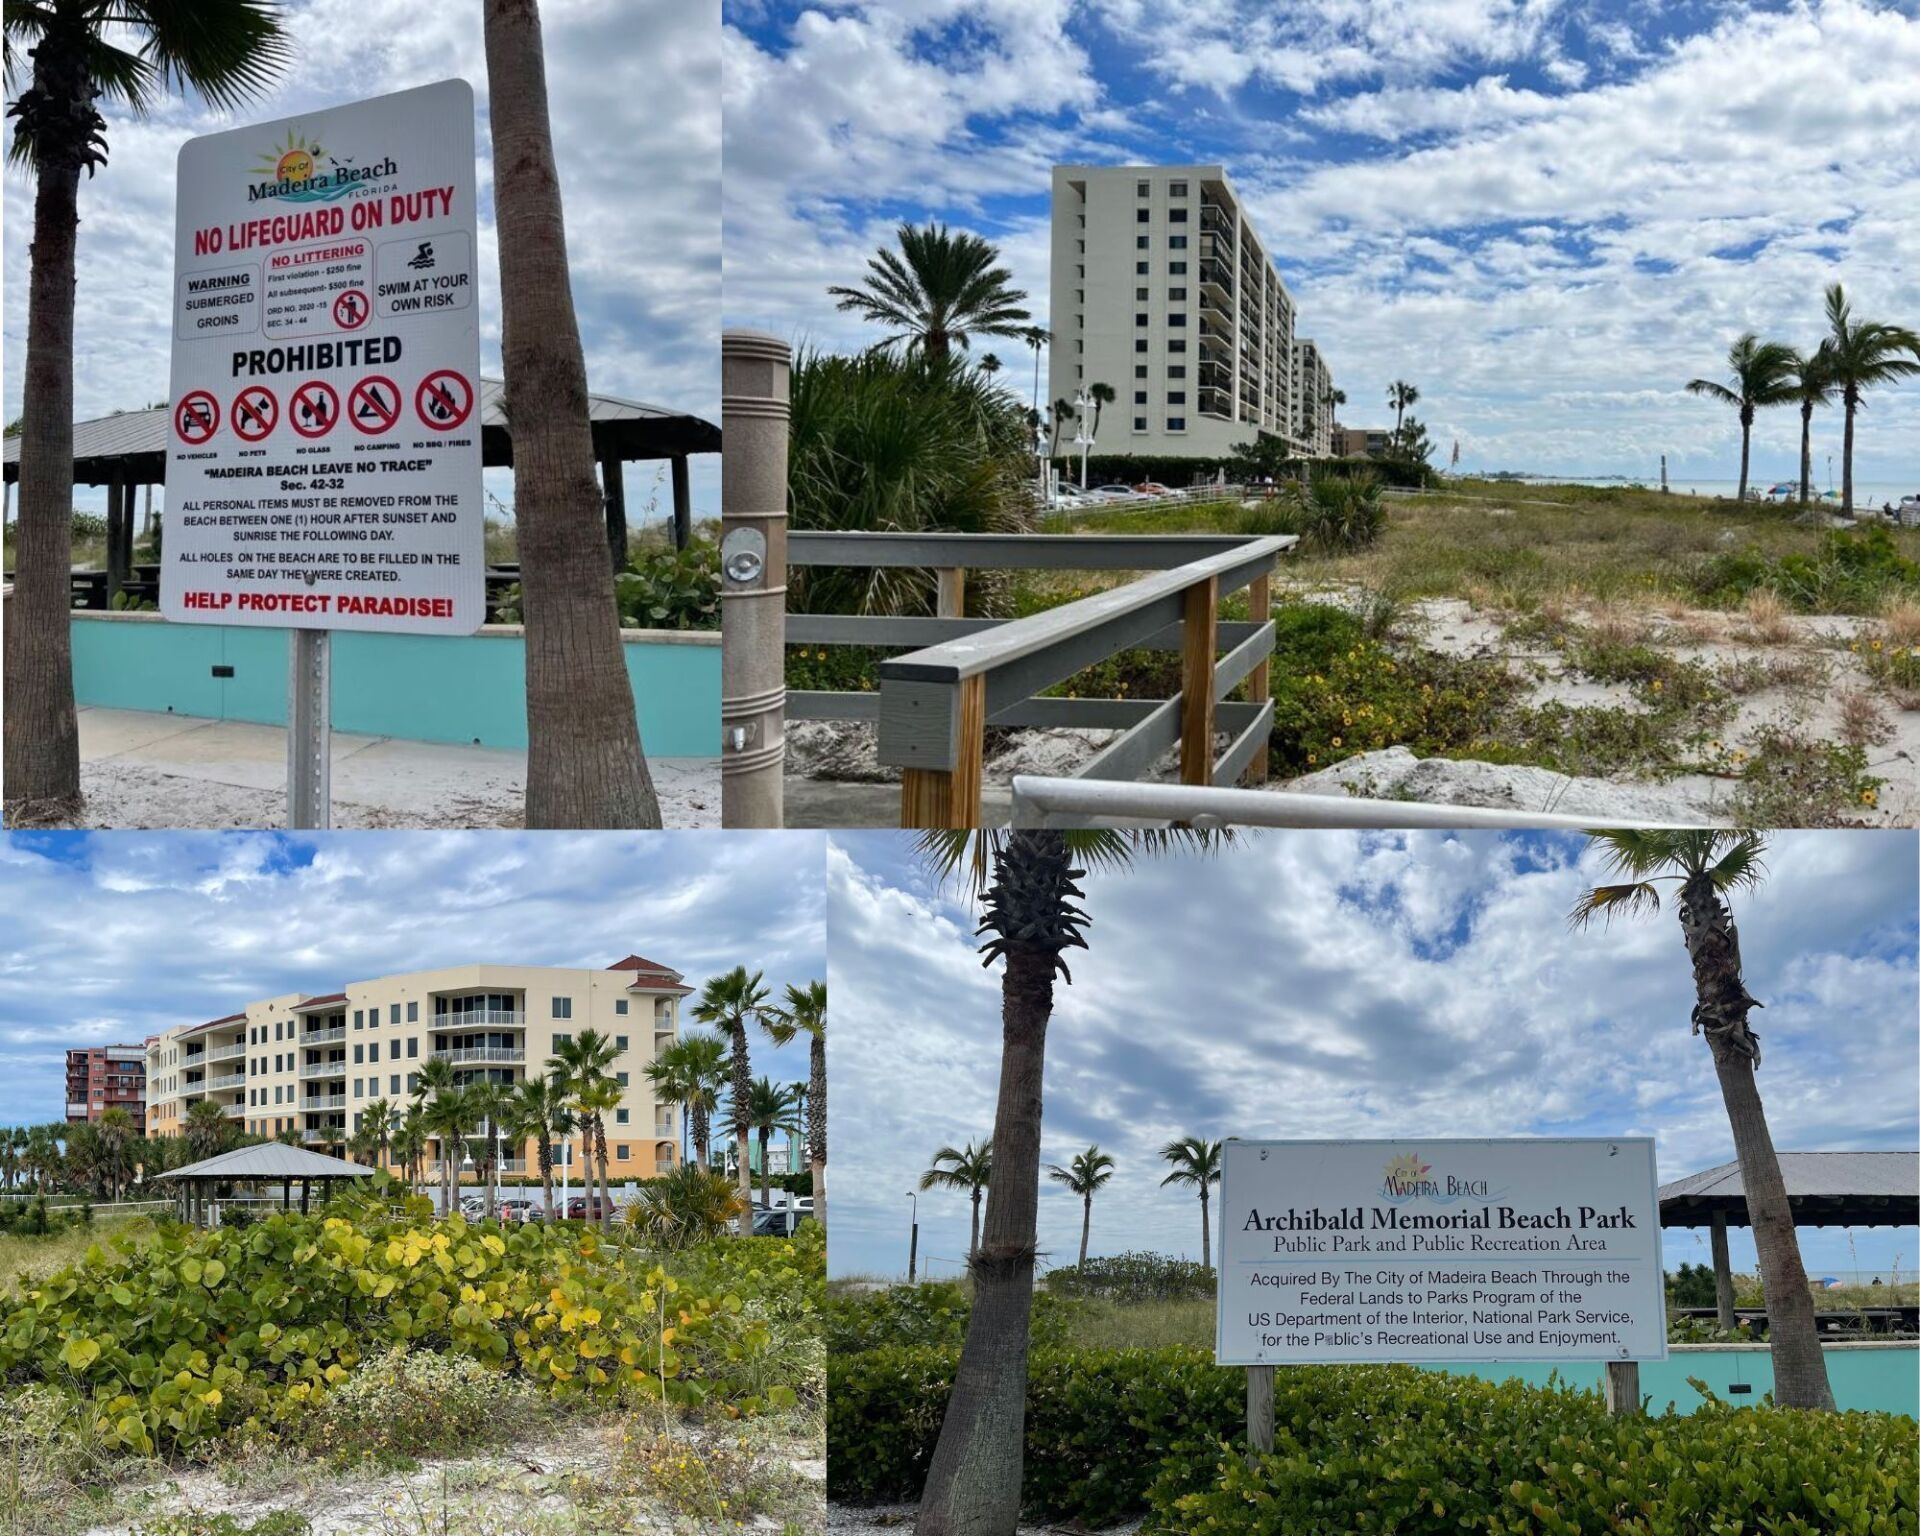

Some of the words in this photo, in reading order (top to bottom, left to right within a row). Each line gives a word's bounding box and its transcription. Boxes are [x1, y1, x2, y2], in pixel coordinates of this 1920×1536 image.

[248, 174, 328, 201] Madeira
[336, 157, 398, 184] Beach
[349, 184, 398, 198] FLORIDA
[195, 227, 222, 256] NO
[229, 207, 344, 250] LIFEGUARD
[351, 200, 382, 230] ON
[391, 186, 454, 222] DUTY
[272, 256, 290, 267] NO
[294, 244, 364, 263] LITTERING
[287, 269, 319, 280] violation
[326, 266, 344, 275] $250
[188, 274, 251, 292] WARNING
[268, 290, 278, 298] All
[329, 281, 346, 290] $500
[378, 281, 410, 297] SWIM
[414, 278, 428, 291] AT
[430, 273, 469, 290] YOUR
[186, 292, 255, 311] SUBMERGED
[391, 296, 421, 312] OWN
[424, 292, 455, 308] RISK
[197, 314, 239, 329] GROINS
[233, 335, 402, 377] PROHIBITED
[266, 463, 309, 476] BEACH
[312, 462, 353, 475] LEAVE
[356, 460, 382, 473] NO
[280, 479, 307, 491] Sec.
[310, 479, 345, 490] 42-32
[182, 500, 201, 511] ALL
[203, 499, 256, 510] PERSONAL
[258, 498, 289, 509] ITEMS
[291, 498, 321, 508] MUST
[323, 498, 337, 508] BE
[339, 496, 395, 507] REMOVED
[398, 496, 433, 506] FROM
[435, 495, 458, 505] THE
[183, 515, 217, 526] BEACH
[219, 515, 269, 526] BETWEEN
[270, 514, 293, 525] ONE
[294, 513, 308, 527] (1)
[310, 513, 342, 525] HOUR
[344, 513, 379, 524] AFTER
[382, 513, 429, 523] SUNSET
[431, 513, 456, 523] AND
[233, 531, 277, 541] SUNRISE
[280, 530, 301, 541] THE
[303, 530, 368, 541] FOLLOWING
[370, 530, 394, 540] DAY.
[180, 553, 199, 562] ALL
[200, 553, 233, 563] HOLES
[238, 553, 253, 563] ON
[255, 553, 276, 563] THE
[279, 553, 316, 563] BEACH
[317, 553, 340, 563] ARE
[342, 553, 358, 564] TO
[361, 554, 376, 564] BE
[378, 554, 419, 564] FILLED
[421, 554, 433, 564] IN
[435, 554, 460, 565] THE
[227, 569, 255, 579] SAME
[257, 569, 279, 580] DAY
[281, 569, 309, 580] THEY
[311, 570, 343, 581] WERE
[345, 570, 401, 582] CREATED.
[184, 592, 233, 609] HELP
[238, 592, 331, 613] PROTECT
[337, 596, 454, 618] PARADISE!
[1242, 1208, 1364, 1231] Archibald
[1370, 1207, 1490, 1231] Memorial
[1497, 1207, 1572, 1229] Beach
[1579, 1206, 1637, 1228] Park
[1273, 1235, 1326, 1254] Public
[1332, 1235, 1370, 1253] Park
[1375, 1235, 1406, 1253] and
[1412, 1234, 1464, 1252] Public
[1470, 1233, 1561, 1251] Recreation
[1566, 1233, 1607, 1251] Area
[1250, 1272, 1316, 1288] Acquired
[1321, 1272, 1340, 1287] By
[1344, 1272, 1372, 1285] The
[1376, 1271, 1405, 1287] City
[1408, 1270, 1423, 1285] of
[1428, 1270, 1486, 1285] Madeira
[1491, 1270, 1538, 1285] Beach
[1541, 1269, 1602, 1287] Through
[1606, 1269, 1630, 1284] the
[1300, 1292, 1354, 1305] Federal
[1359, 1292, 1403, 1305] Lands
[1408, 1292, 1423, 1305] to
[1426, 1291, 1468, 1304] Parks
[1472, 1290, 1535, 1307] Program
[1539, 1290, 1555, 1304] of
[1559, 1290, 1582, 1303] the
[1248, 1313, 1270, 1326] US
[1275, 1313, 1362, 1328] Department
[1365, 1312, 1381, 1326] of
[1384, 1312, 1408, 1325] the
[1412, 1311, 1469, 1328] Interior,
[1472, 1311, 1533, 1325] National
[1538, 1310, 1571, 1324] Park
[1574, 1310, 1634, 1326] Service,
[1262, 1333, 1283, 1346] for
[1286, 1333, 1311, 1346] the
[1313, 1331, 1373, 1346] Pblic’s
[1377, 1331, 1469, 1346] Recreational
[1474, 1331, 1502, 1345] Use
[1506, 1331, 1534, 1345] and
[1539, 1330, 1620, 1347] Enjoyment.
